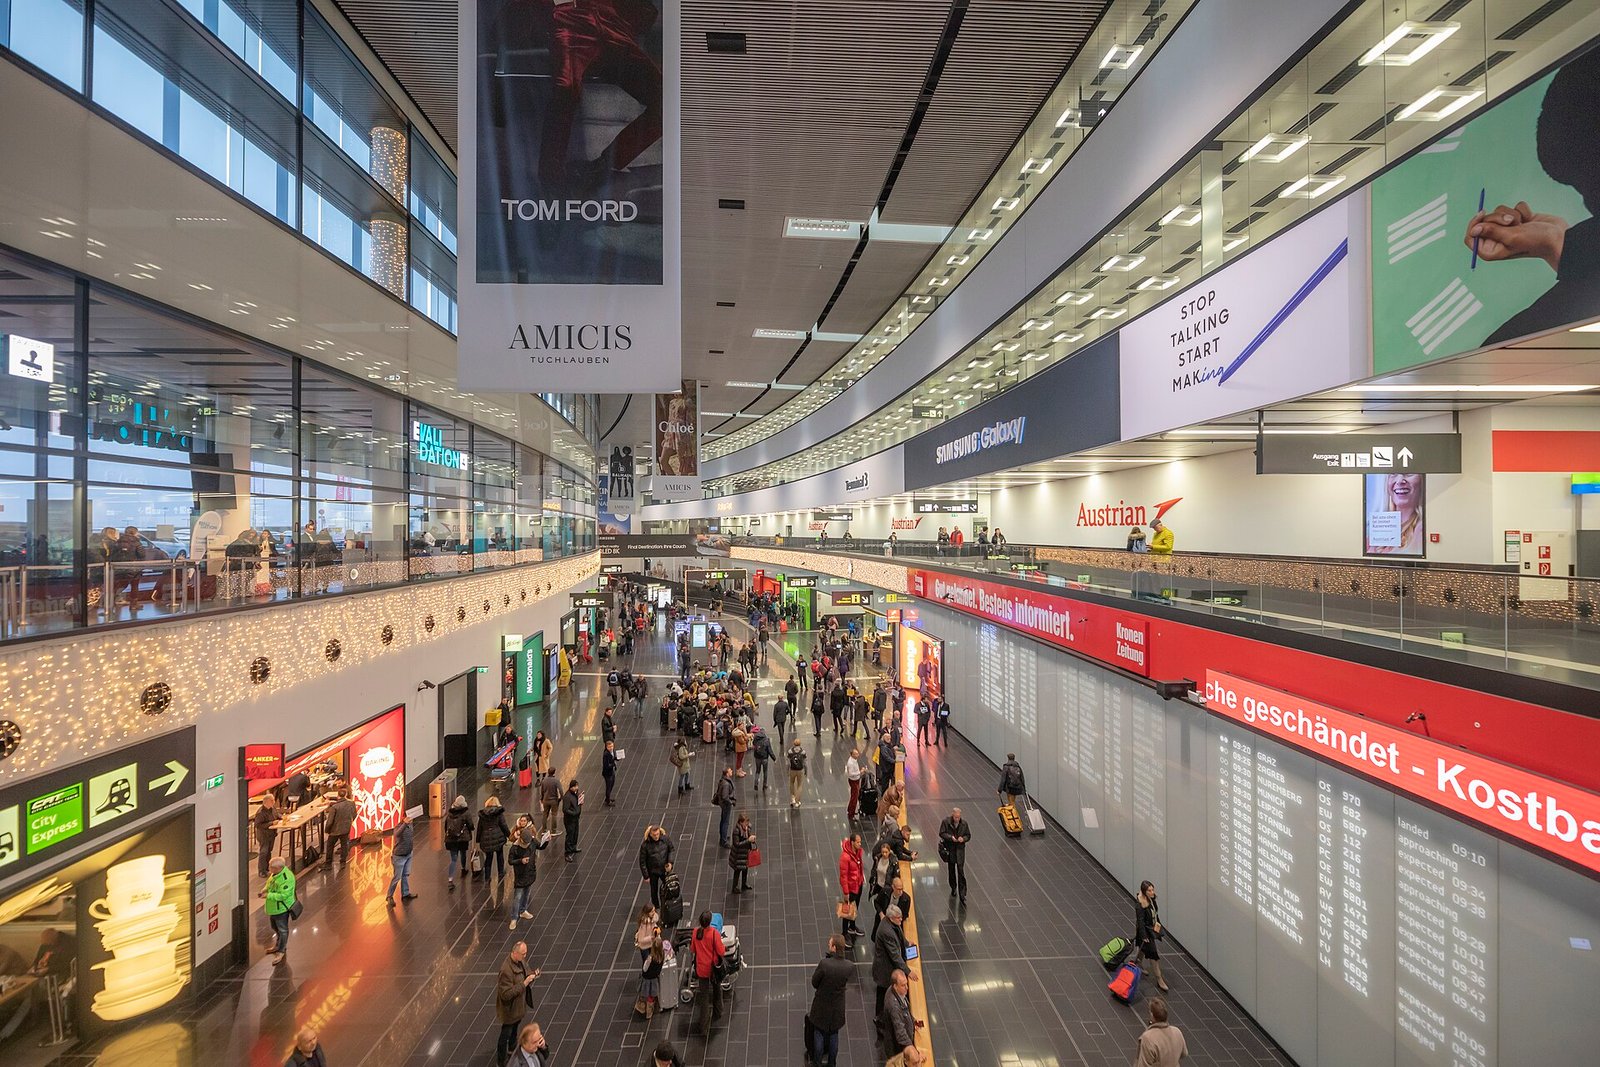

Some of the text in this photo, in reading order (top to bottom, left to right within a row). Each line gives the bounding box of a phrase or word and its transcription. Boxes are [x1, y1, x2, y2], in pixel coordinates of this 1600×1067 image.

[501, 199, 638, 222] TOM FORD
[1181, 290, 1216, 320] STOP
[508, 324, 632, 350] AMICIS
[1170, 308, 1230, 347] TALKING
[530, 356, 610, 364] TUCHLAUBEN
[1178, 337, 1220, 367] START
[420, 422, 443, 448] VALI
[658, 420, 694, 434] Chloé
[936, 416, 1025, 464] SAMSUNG Galaxy
[420, 442, 460, 469] DATION
[864, 472, 868, 487] 3
[808, 521, 824, 531] Austrian
[891, 517, 914, 530] Austrian
[1076, 500, 1147, 526] Austrian
[978, 588, 1013, 620] Bestens
[1015, 596, 1075, 642] informiert.
[1116, 622, 1144, 646] Kronen
[1116, 640, 1144, 666] Zeitung
[1243, 696, 1401, 775] geschändet
[32, 814, 58, 830] City
[1233, 741, 1486, 866] 09:20 GRAZ OS 970 landed 09:10
[1233, 752, 1458, 872] 09:25 ZAGREB OS 682 approaching
[32, 818, 78, 844] Express
[1233, 763, 1251, 777] 09:30
[1258, 775, 1302, 804] NUREMBERG
[1319, 807, 1332, 820] EW
[1398, 850, 1444, 880] expected
[1452, 876, 1486, 902] 09:34
[1233, 774, 1486, 919] 09:30 MUNICH OS 112 expected 09:38
[1233, 785, 1458, 922] 09:30 LEIPZIG OS 216 approaching
[1233, 796, 1486, 953] 09:40 ISTANBUL PC 901 expected 09:28
[1233, 808, 1485, 971] 09:50 SOFIA OE 183 expected 10:01
[1234, 853, 1252, 870] 10:05
[1258, 868, 1280, 890] MILAN
[1284, 887, 1300, 902] MXP
[1320, 914, 1332, 928] OS
[1234, 819, 1252, 836] 09:55
[1258, 834, 1294, 863] HANOVER
[1320, 873, 1332, 887] EW
[1398, 926, 1444, 961] expected
[1452, 960, 1486, 988] 09:36
[1234, 830, 1252, 847] 10:00
[1258, 845, 1290, 872] HELSINKI
[1344, 902, 1367, 926] 1471
[1398, 941, 1444, 978] expected
[1234, 842, 1252, 858] 10:00
[1258, 858, 1280, 878] OHRID
[1320, 899, 1334, 916] W6
[1344, 916, 1368, 940] 2826
[1398, 956, 1444, 994] expected
[1234, 875, 1252, 894] 10:10
[1258, 892, 1269, 907] ST.
[1344, 958, 1368, 983] 6603
[1398, 1002, 1444, 1042] expected
[1234, 864, 1252, 882] 10:05
[1258, 881, 1303, 920] BARCELONA
[1344, 944, 1368, 968] 8714
[1398, 986, 1444, 1026] expected
[1453, 1026, 1486, 1056] 10:09
[1234, 886, 1435, 1051] 10:10 FRANKFURT LH 1234 delayed
